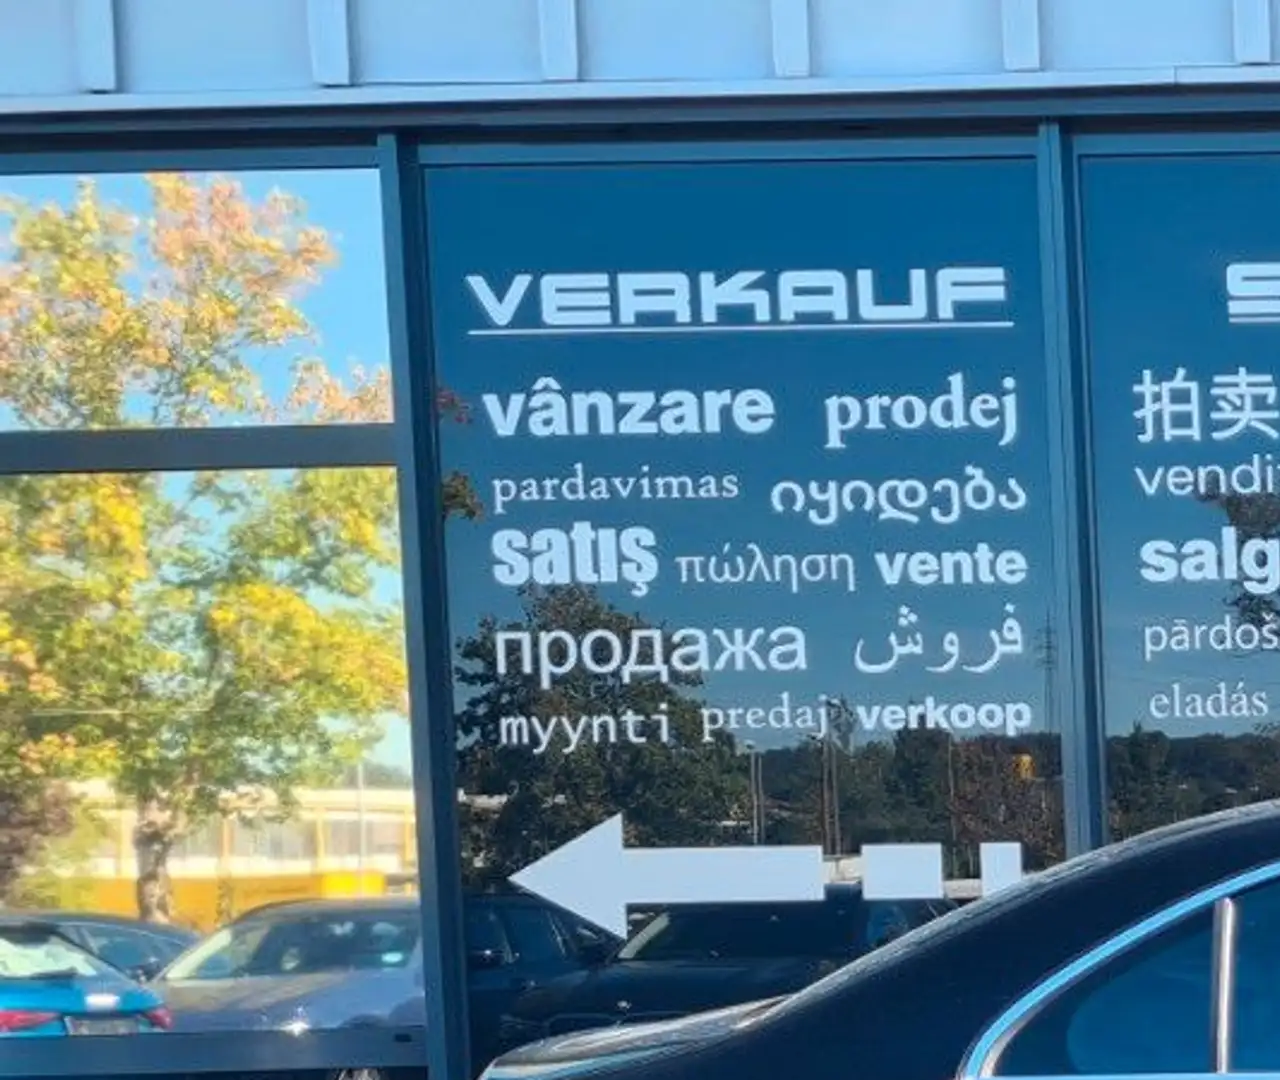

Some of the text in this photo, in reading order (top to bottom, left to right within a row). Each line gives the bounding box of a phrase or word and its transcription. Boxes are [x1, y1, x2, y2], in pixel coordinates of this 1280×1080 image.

[466, 266, 1006, 326] VERKAUF
[482, 372, 1017, 449] vânzare prodej
[1132, 367, 1280, 443] 拍卖
[492, 462, 739, 515] pardavimas
[771, 465, 1027, 526] იყიდება
[492, 521, 658, 597] satış
[675, 543, 855, 593] πώληση
[874, 543, 1028, 586] vente
[495, 626, 808, 690] продажа
[500, 691, 1032, 754] myynti predaj verkoop
[1149, 682, 1269, 719] eladás
